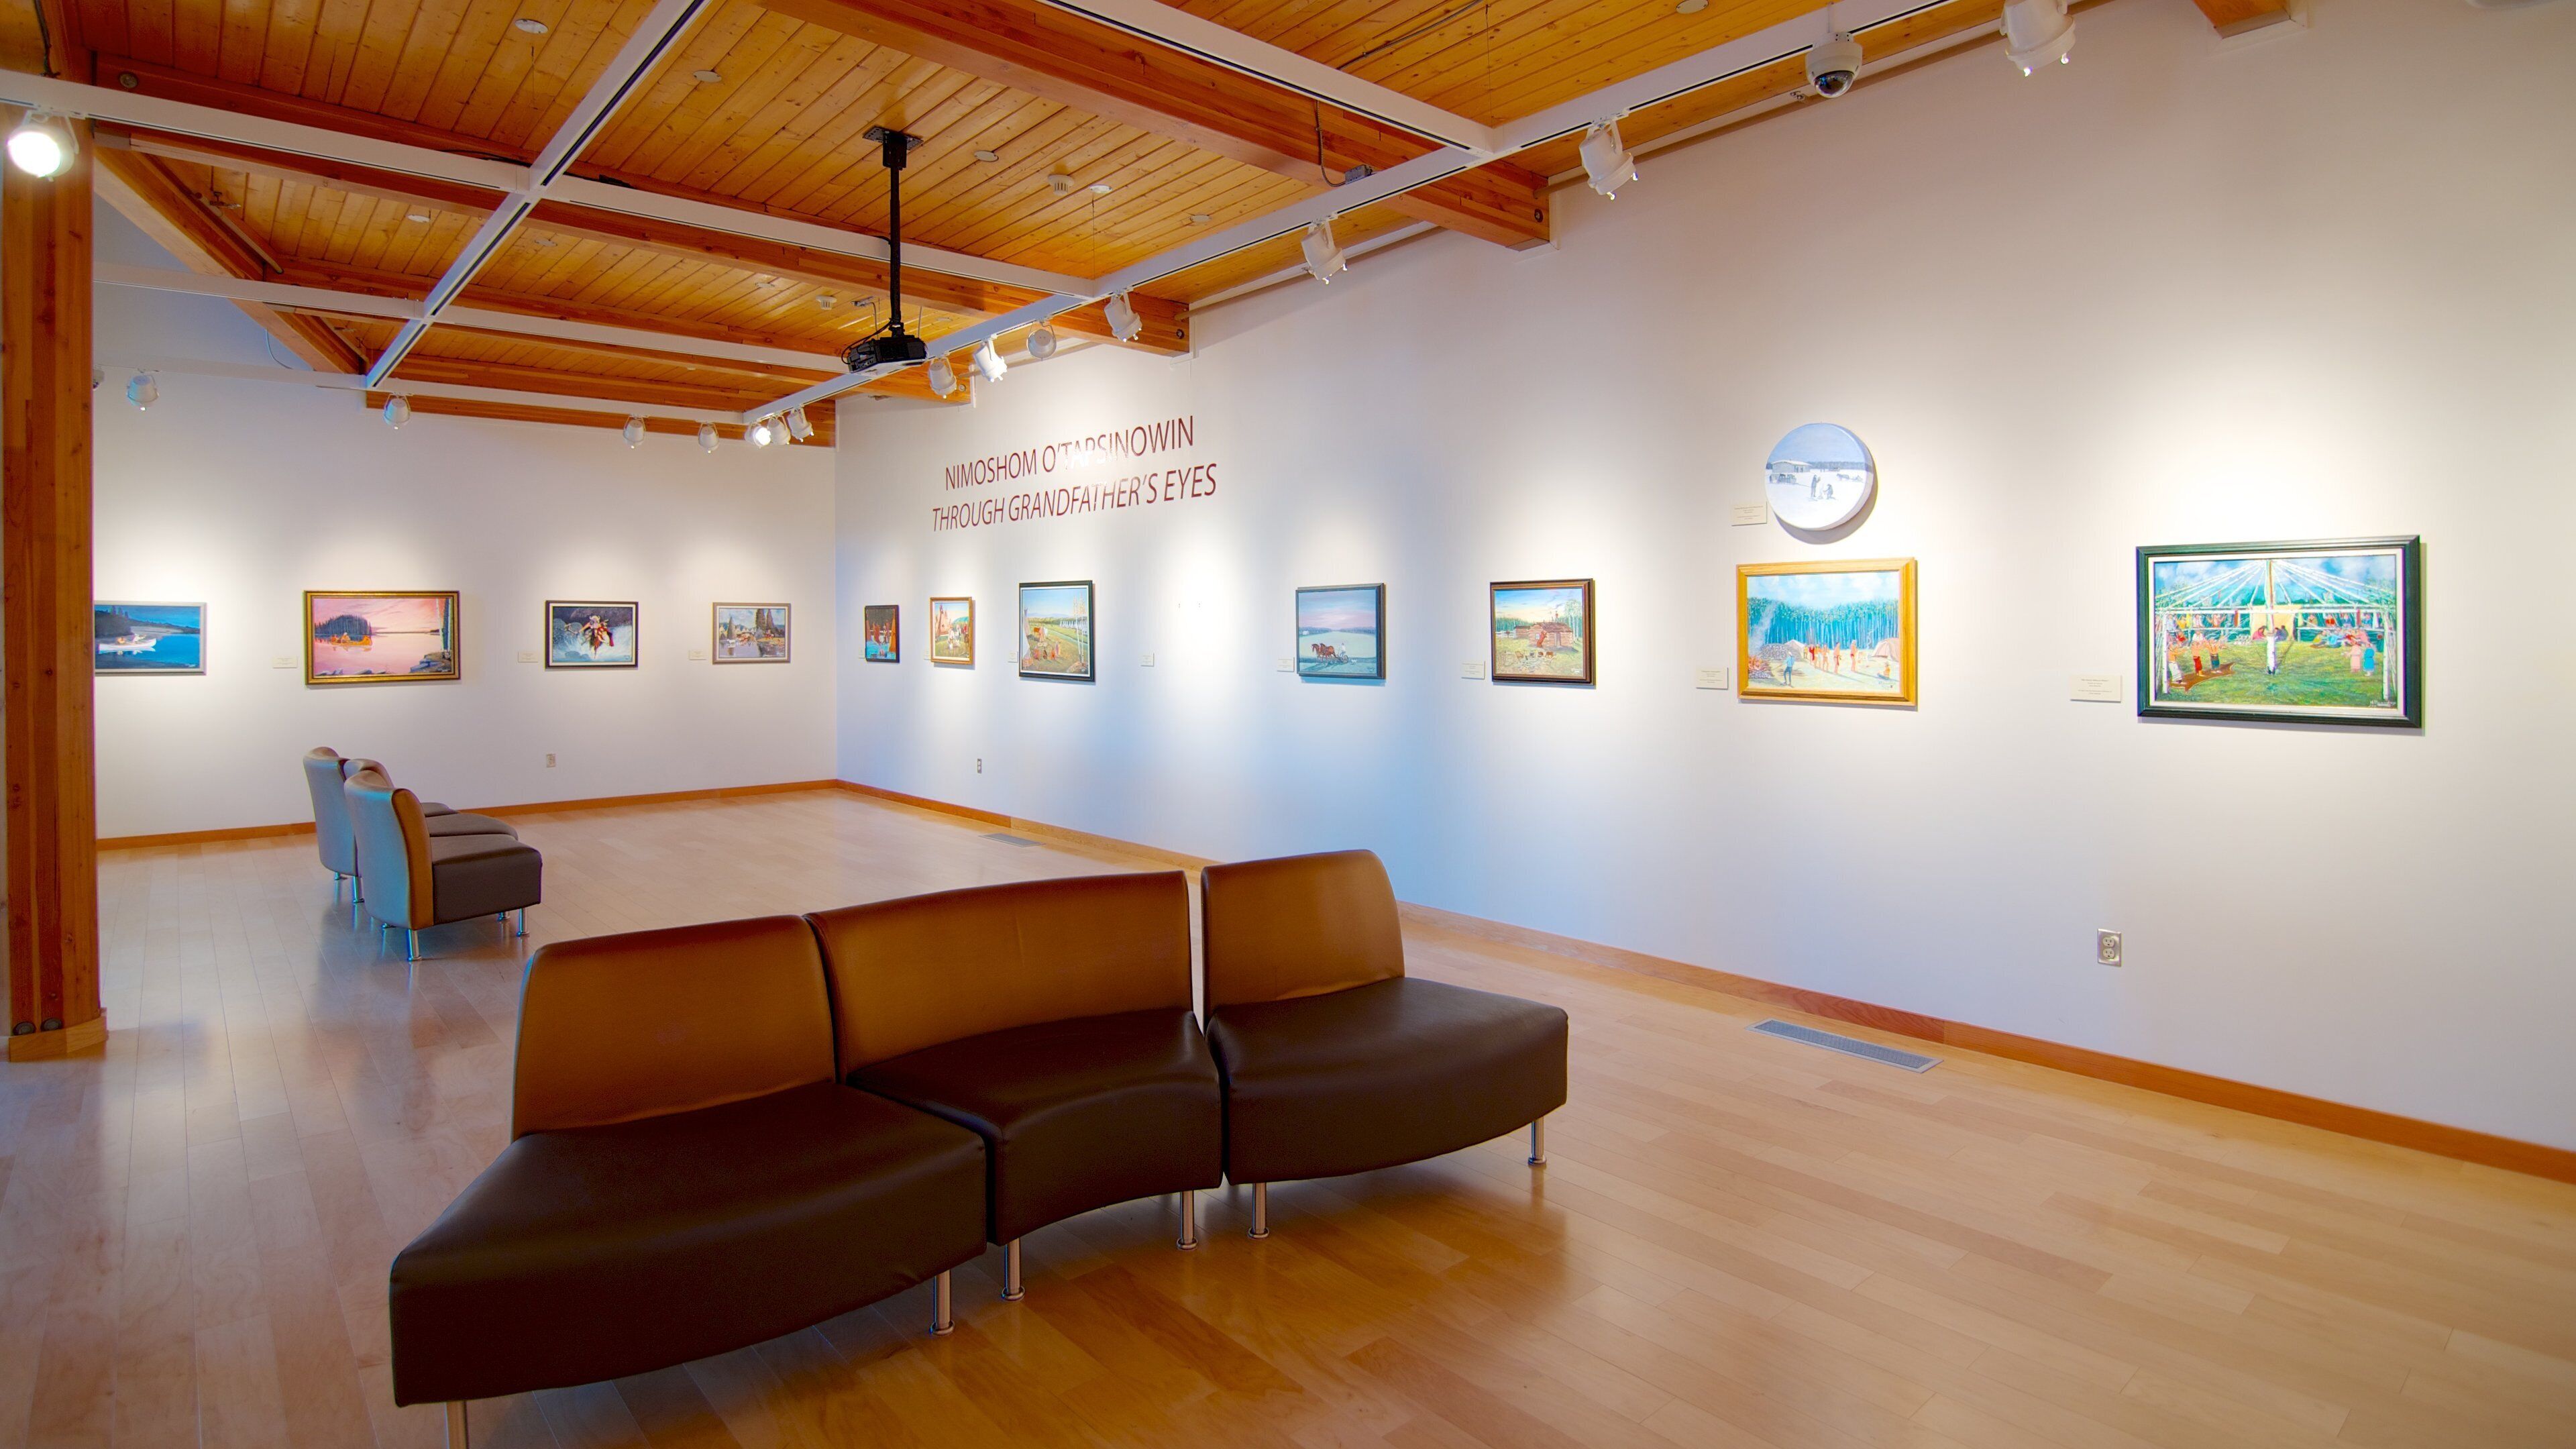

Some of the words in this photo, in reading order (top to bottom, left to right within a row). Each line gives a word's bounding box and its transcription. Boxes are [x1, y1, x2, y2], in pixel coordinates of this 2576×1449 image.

[932, 498, 1005, 532] THROUGH
[1008, 472, 1159, 522] GRANDFATHER'S
[1163, 463, 1218, 502] EYES
[945, 449, 1037, 491] NIMOSHOM
